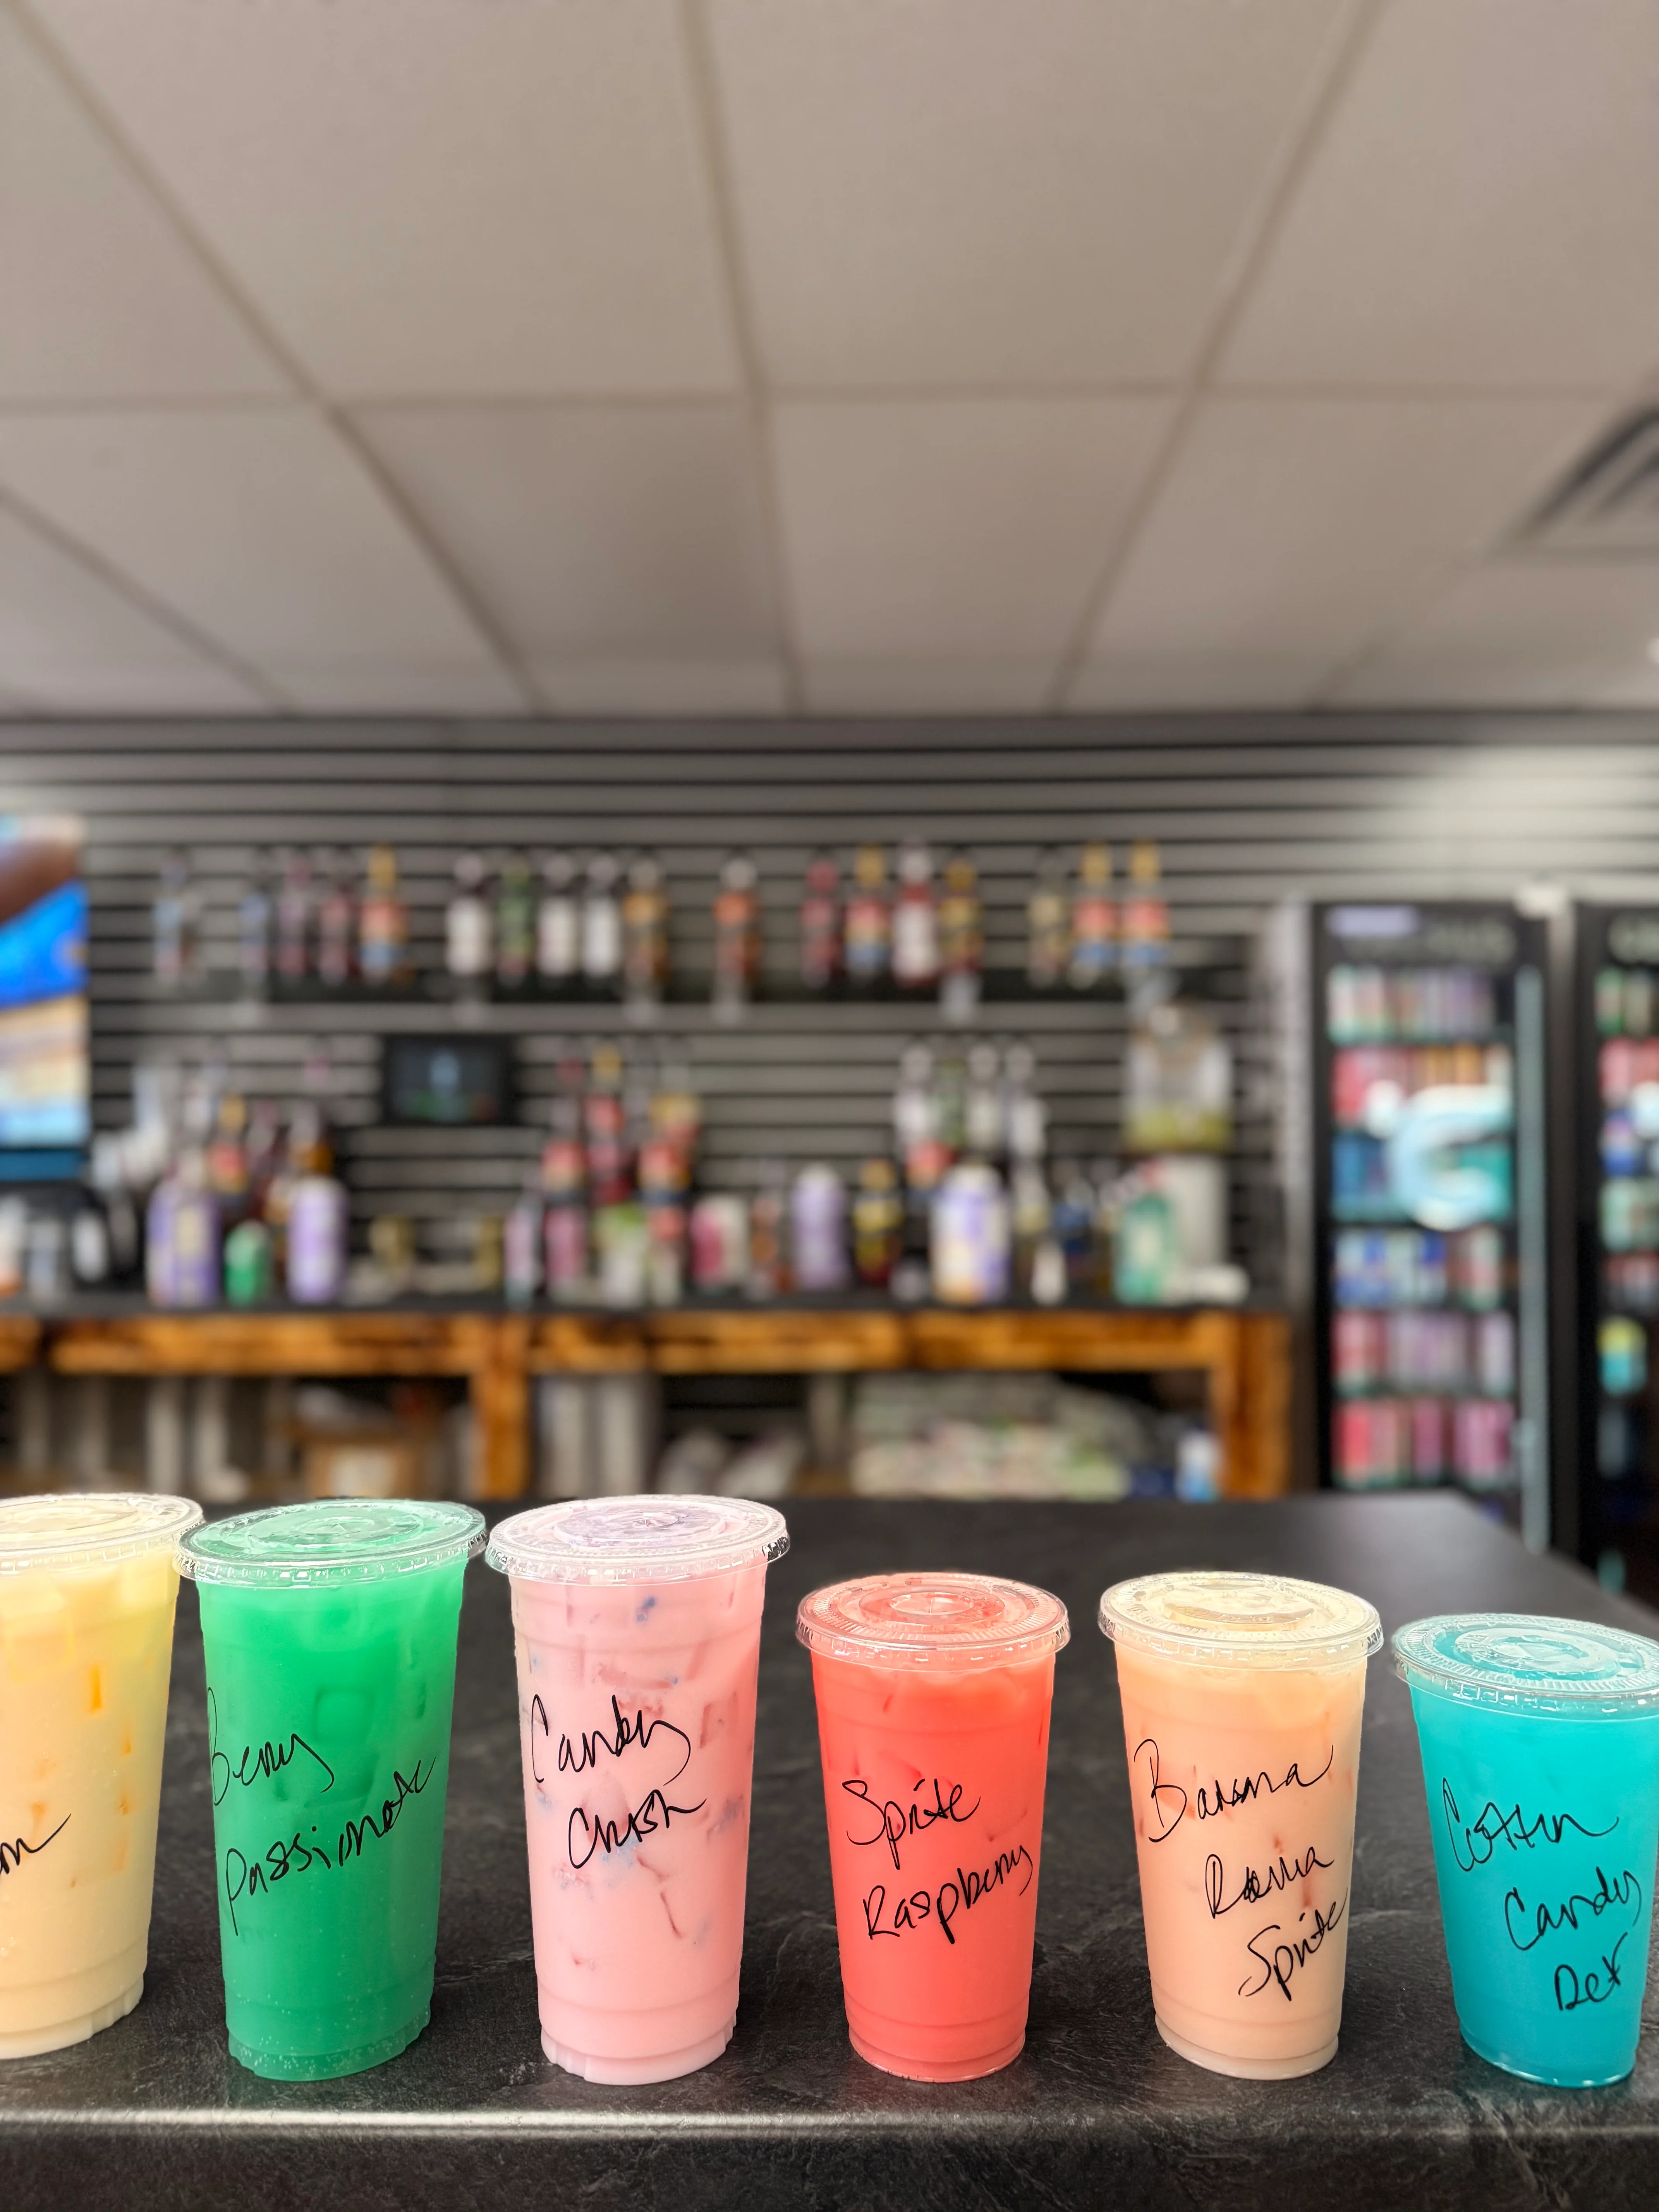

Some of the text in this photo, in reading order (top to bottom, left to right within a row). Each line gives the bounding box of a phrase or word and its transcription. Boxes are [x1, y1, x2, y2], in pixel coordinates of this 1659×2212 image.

[531, 1694, 692, 1786] Candy
[842, 1778, 981, 1870] Sprite
[862, 1844, 1033, 1944] Raspberry
[1504, 1866, 1642, 1951] Candy
[1238, 1887, 1348, 2002] Sprite
